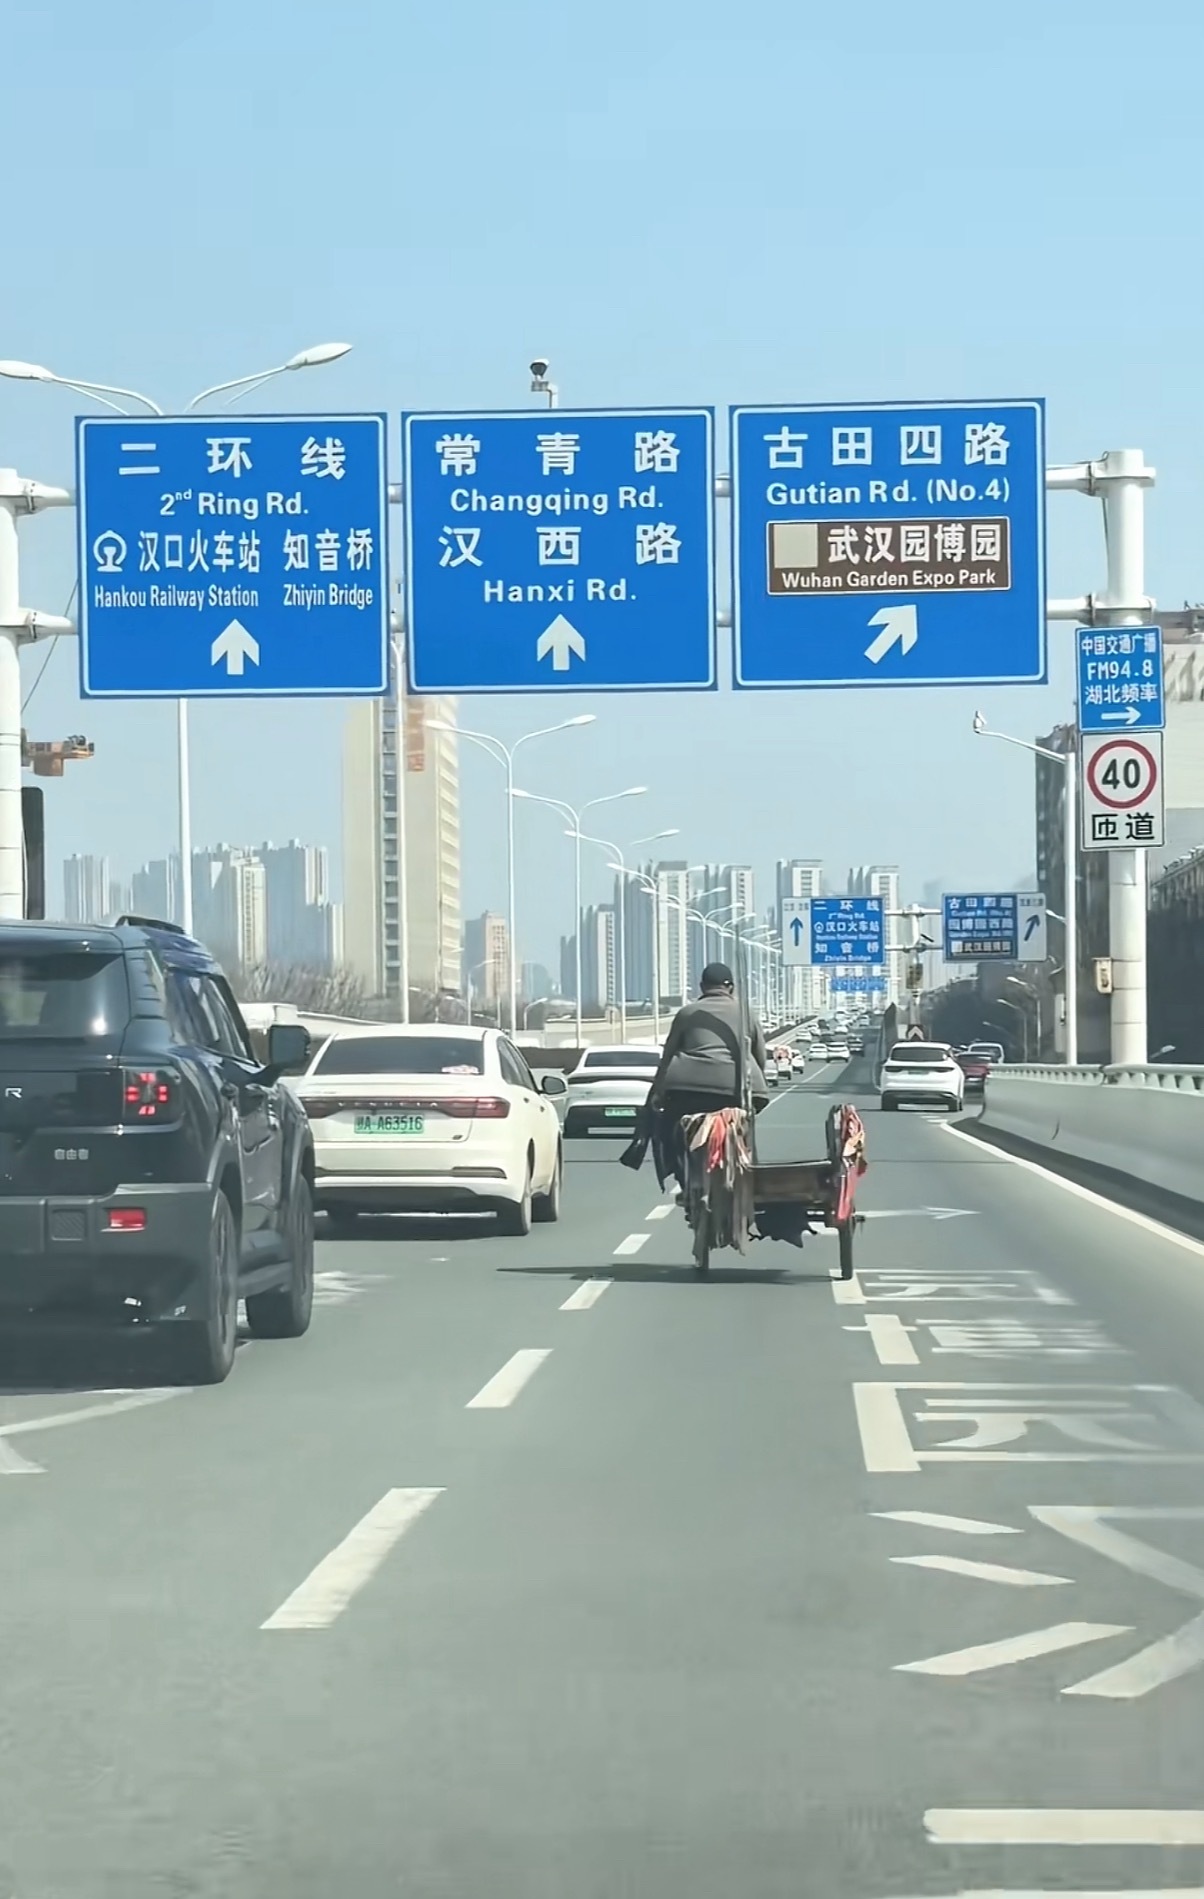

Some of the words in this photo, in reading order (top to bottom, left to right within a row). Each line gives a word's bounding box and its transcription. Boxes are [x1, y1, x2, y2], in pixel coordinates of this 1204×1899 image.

[118, 436, 346, 480] 二环线
[435, 430, 681, 476] 常青路
[763, 422, 1010, 468] 古田四路
[159, 488, 192, 516] 2nd
[198, 491, 259, 520] Ring
[266, 491, 309, 515] Rd.
[450, 487, 609, 515] Changqing
[618, 485, 664, 509] Rd.
[766, 482, 861, 505] Gutian
[869, 479, 917, 502] Rd.
[926, 477, 1010, 503] (No.4)
[138, 528, 261, 573] 汉口火车站
[283, 527, 374, 572] 知音桥
[438, 521, 682, 567] 汉西路
[827, 523, 1001, 564] 武汉园博园
[484, 579, 575, 603] Hanxi
[586, 578, 637, 601] Rd.
[782, 572, 842, 588] Wuhan
[846, 571, 909, 587] Garden
[912, 570, 955, 587] Expo
[959, 568, 996, 584] Park
[94, 585, 147, 607] Hankou
[150, 585, 205, 611] Railway
[208, 584, 259, 607] Station
[283, 583, 326, 611] Zhiyin
[328, 583, 373, 610] Bridge
[1087, 659, 1154, 681] FM94.8
[1084, 681, 1158, 704] 湖北频率
[1101, 758, 1141, 790] 40
[1091, 812, 1155, 841] 匝道
